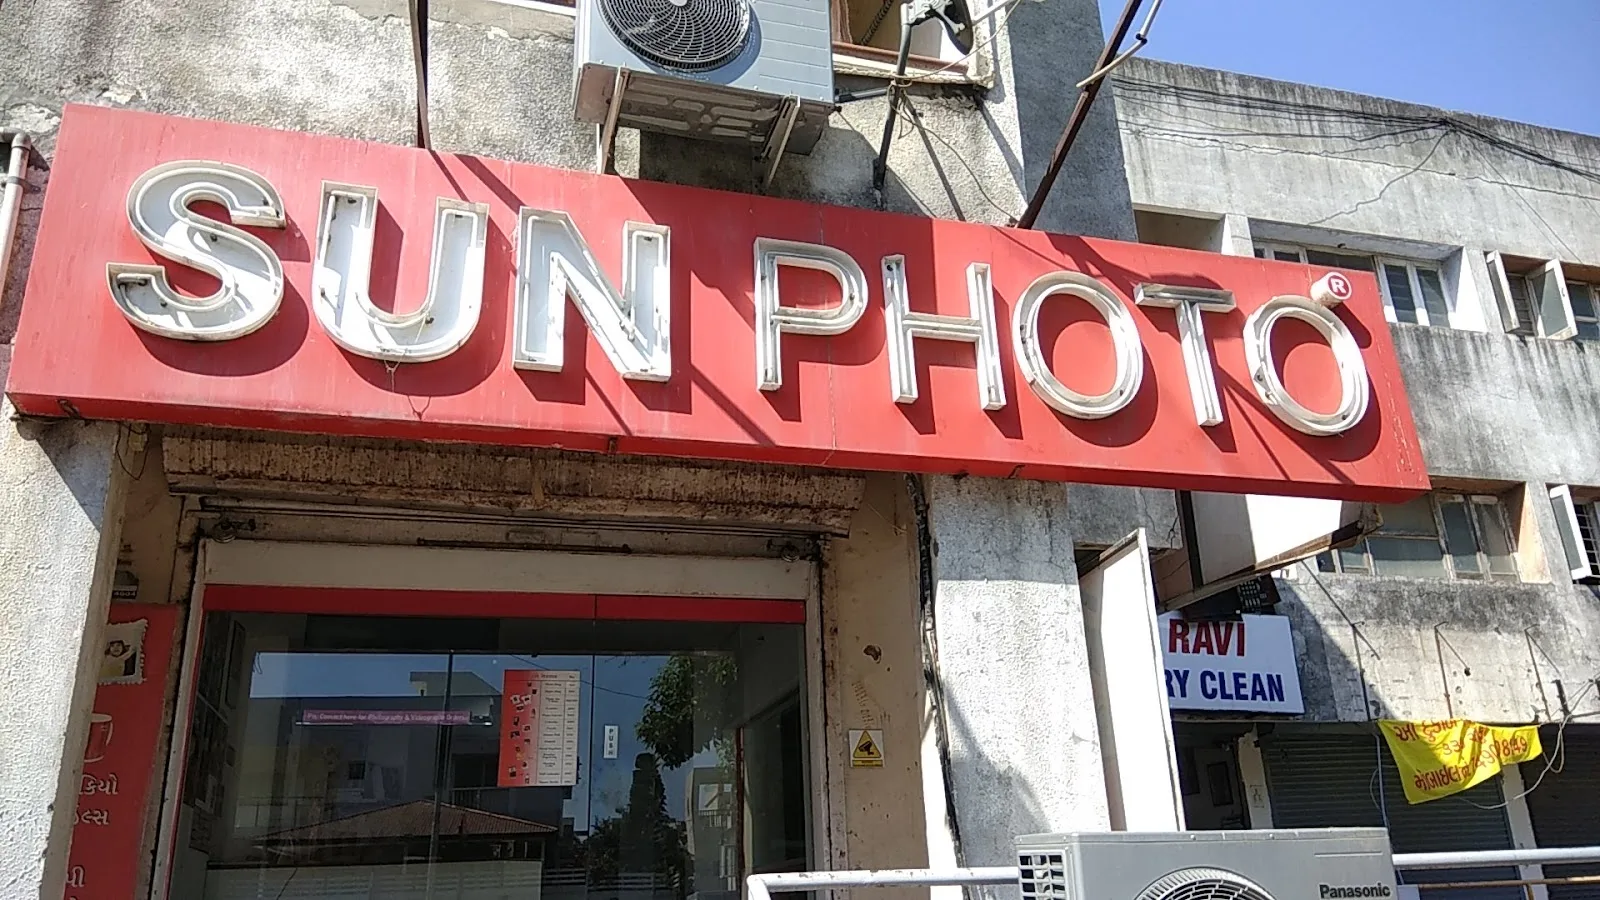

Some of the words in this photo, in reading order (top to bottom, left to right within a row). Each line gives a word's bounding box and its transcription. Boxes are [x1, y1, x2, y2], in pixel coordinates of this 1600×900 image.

[107, 160, 671, 382] SUN
[754, 236, 1369, 436] PHOTO
[1168, 618, 1245, 657] RAVI
[1200, 670, 1285, 702] CLEAN
[1319, 882, 1391, 899] Panasonic
